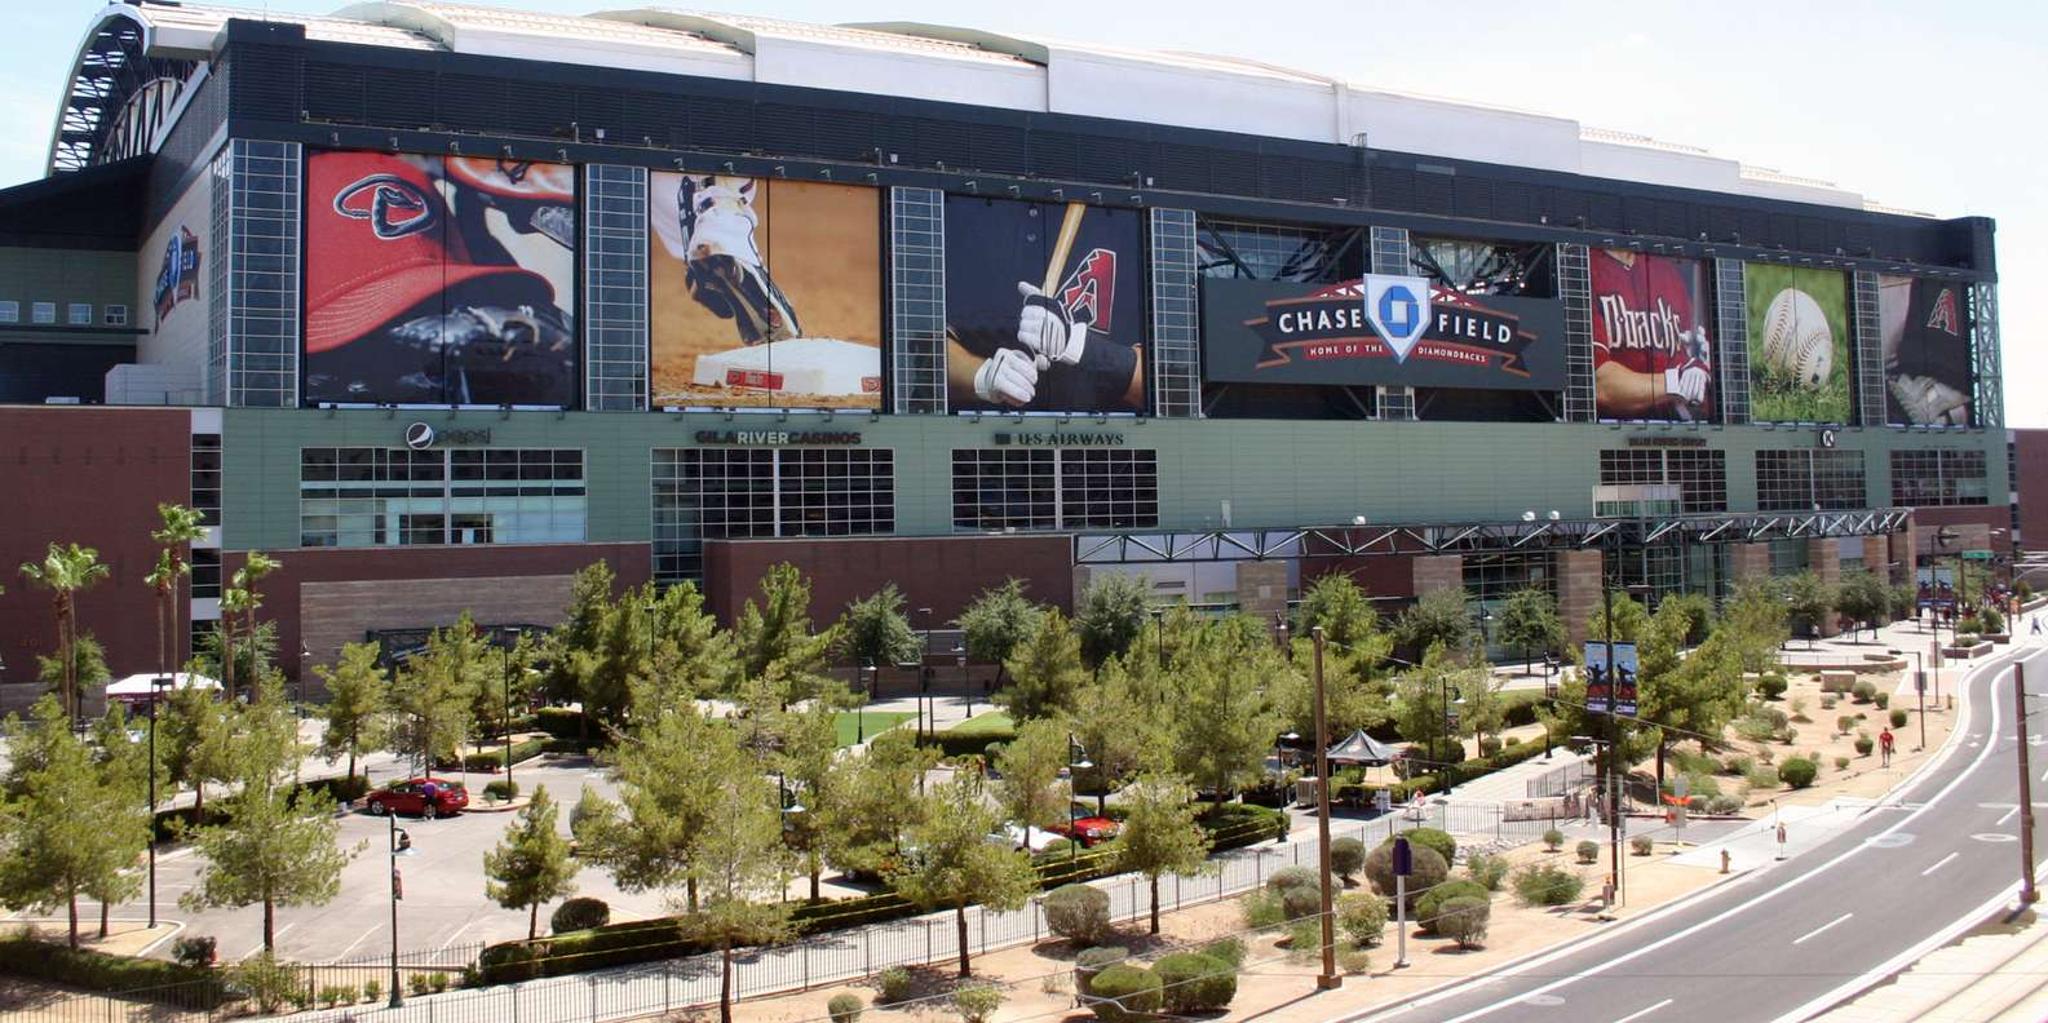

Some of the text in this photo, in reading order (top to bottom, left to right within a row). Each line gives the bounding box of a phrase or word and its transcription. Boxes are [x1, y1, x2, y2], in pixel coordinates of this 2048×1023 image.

[1278, 308, 1511, 343] CHASE FIELD
[1310, 344, 1487, 363] HOME OF THE DIAMONDBACKS
[1047, 433, 1124, 445] AIRWAYS
